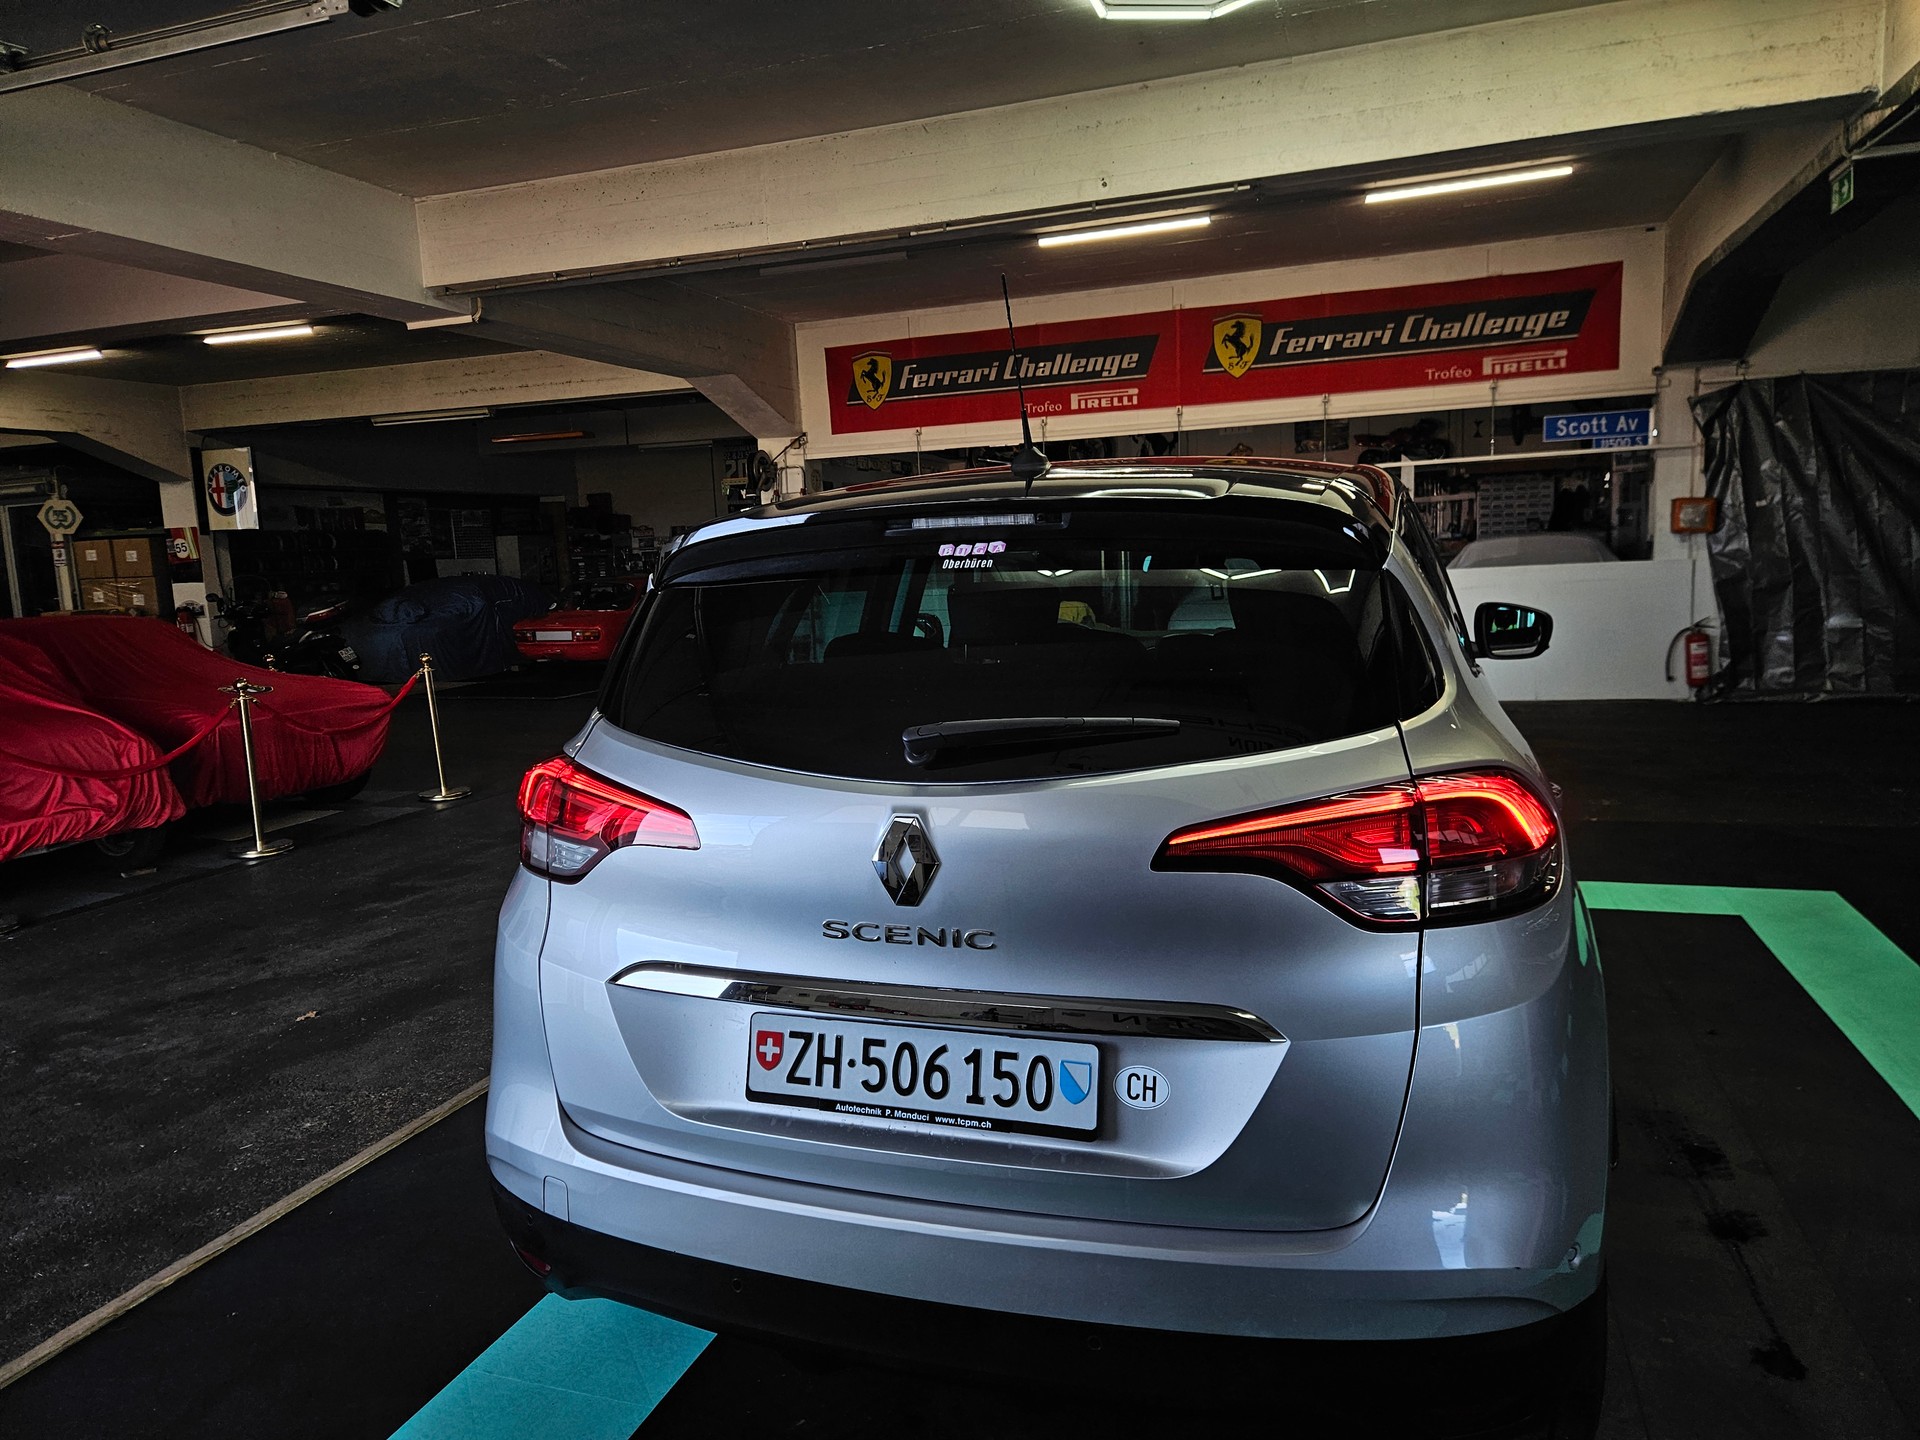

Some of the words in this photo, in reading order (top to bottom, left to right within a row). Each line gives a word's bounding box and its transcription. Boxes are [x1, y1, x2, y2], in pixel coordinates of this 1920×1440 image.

[1269, 323, 1395, 356] Ferrari
[1399, 310, 1570, 344] Challenge
[899, 361, 999, 390] Ferrari
[1003, 352, 1139, 380] Challenge
[1425, 366, 1472, 380] Trofeo
[1482, 348, 1568, 376] PIRELLI
[1023, 400, 1063, 414] Trofeo
[1070, 387, 1139, 410] PIRELLI
[1556, 416, 1609, 436] Scott
[1616, 415, 1639, 432] Av
[175, 542, 188, 554] 55
[942, 558, 993, 570] Oberbüren
[822, 919, 997, 951] SCENIC
[1126, 1073, 1158, 1104] CH
[835, 1103, 882, 1116] Autotechnik
[894, 1110, 930, 1122] Manduci
